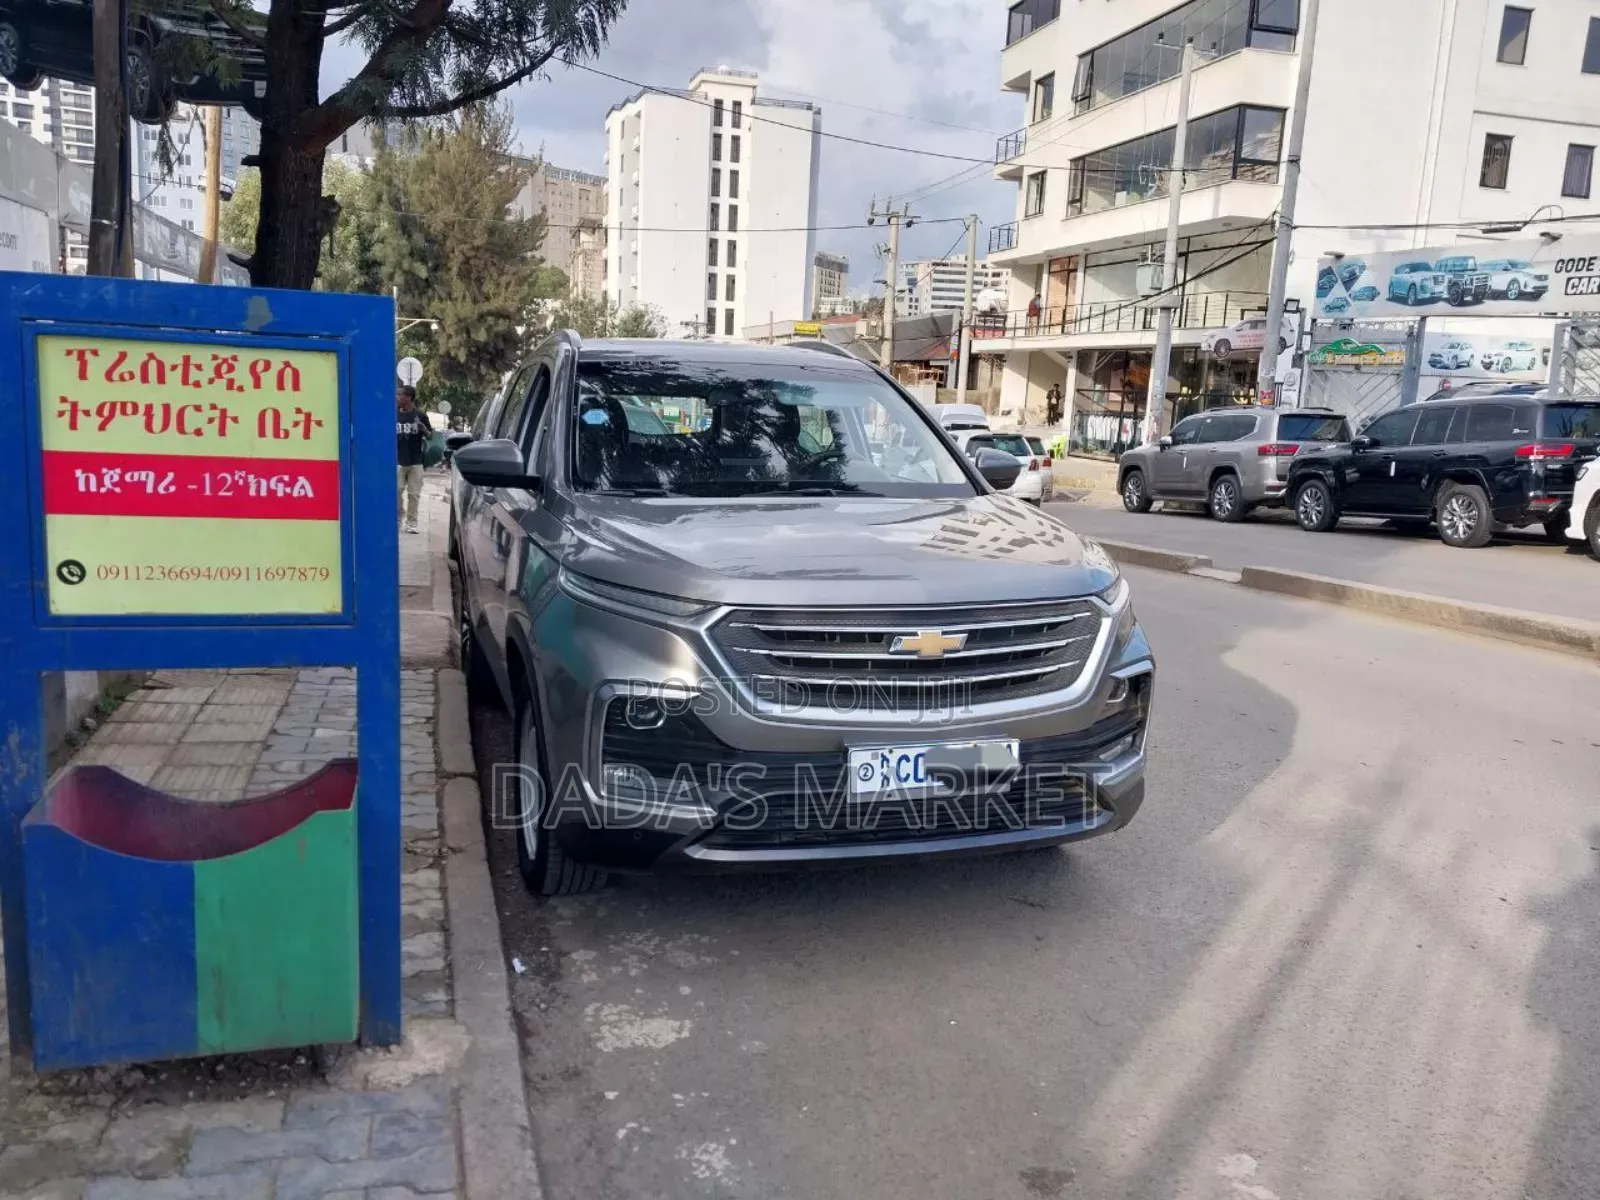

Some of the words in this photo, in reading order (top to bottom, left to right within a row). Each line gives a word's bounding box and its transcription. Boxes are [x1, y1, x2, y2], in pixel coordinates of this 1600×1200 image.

[56, 395, 240, 438] ትምህርት
[257, 406, 323, 440] ቤት
[96, 564, 330, 582] 0911236694/0911697879
